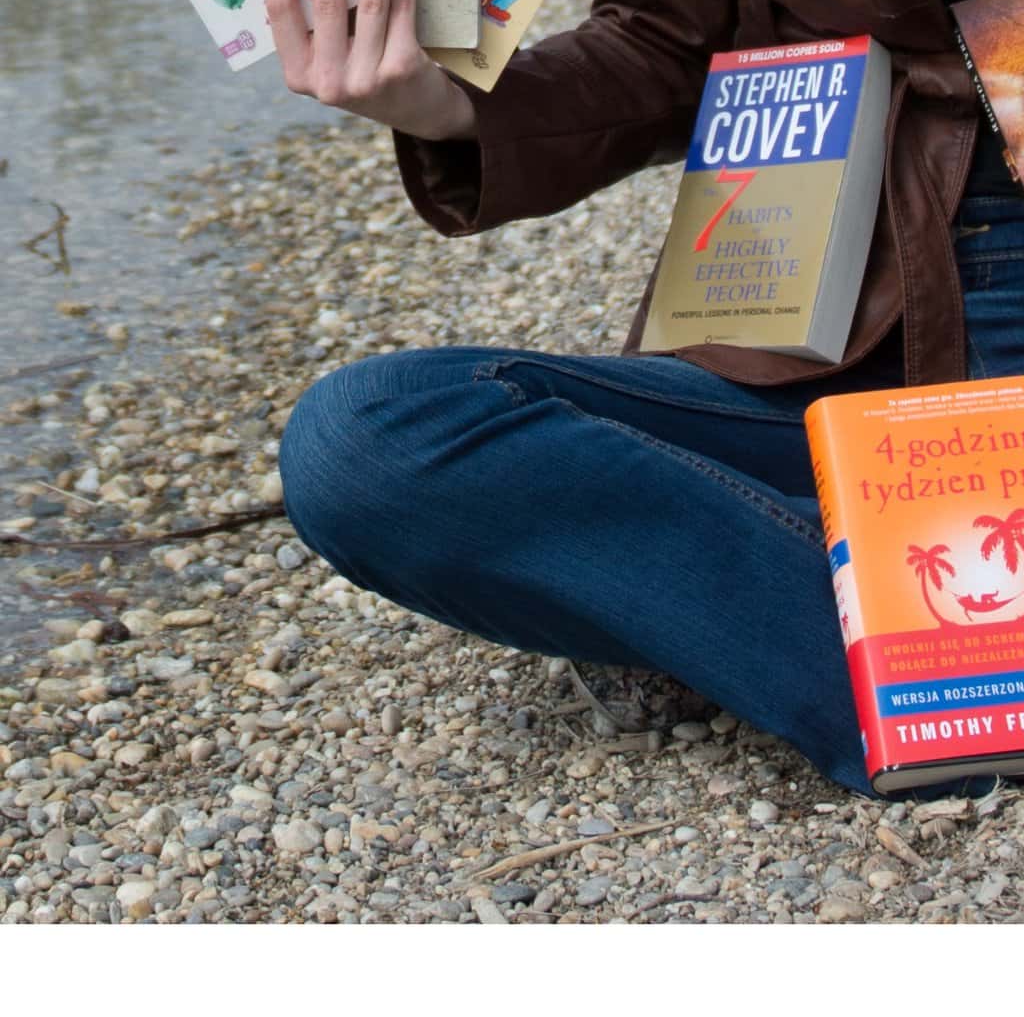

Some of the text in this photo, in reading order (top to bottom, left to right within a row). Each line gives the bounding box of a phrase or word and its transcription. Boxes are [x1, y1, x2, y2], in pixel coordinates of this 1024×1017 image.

[738, 41, 845, 64] 15 MILLION COPIES SOLD!
[715, 63, 848, 108] STEPHEN R.
[702, 101, 839, 165] COVEY
[692, 166, 758, 253] 7
[727, 206, 793, 226] HABITS
[715, 238, 791, 259] HIGHLY
[695, 259, 801, 281] EFFECTIVE
[704, 282, 779, 303] PEOPLE
[671, 310, 703, 320] POWERFUL
[741, 307, 772, 317] PERSONAL
[859, 461, 985, 513] tydzień
[883, 641, 935, 656] UWOLNIJ
[891, 691, 940, 707] WERSJA
[896, 715, 993, 744] TIMOTHY
